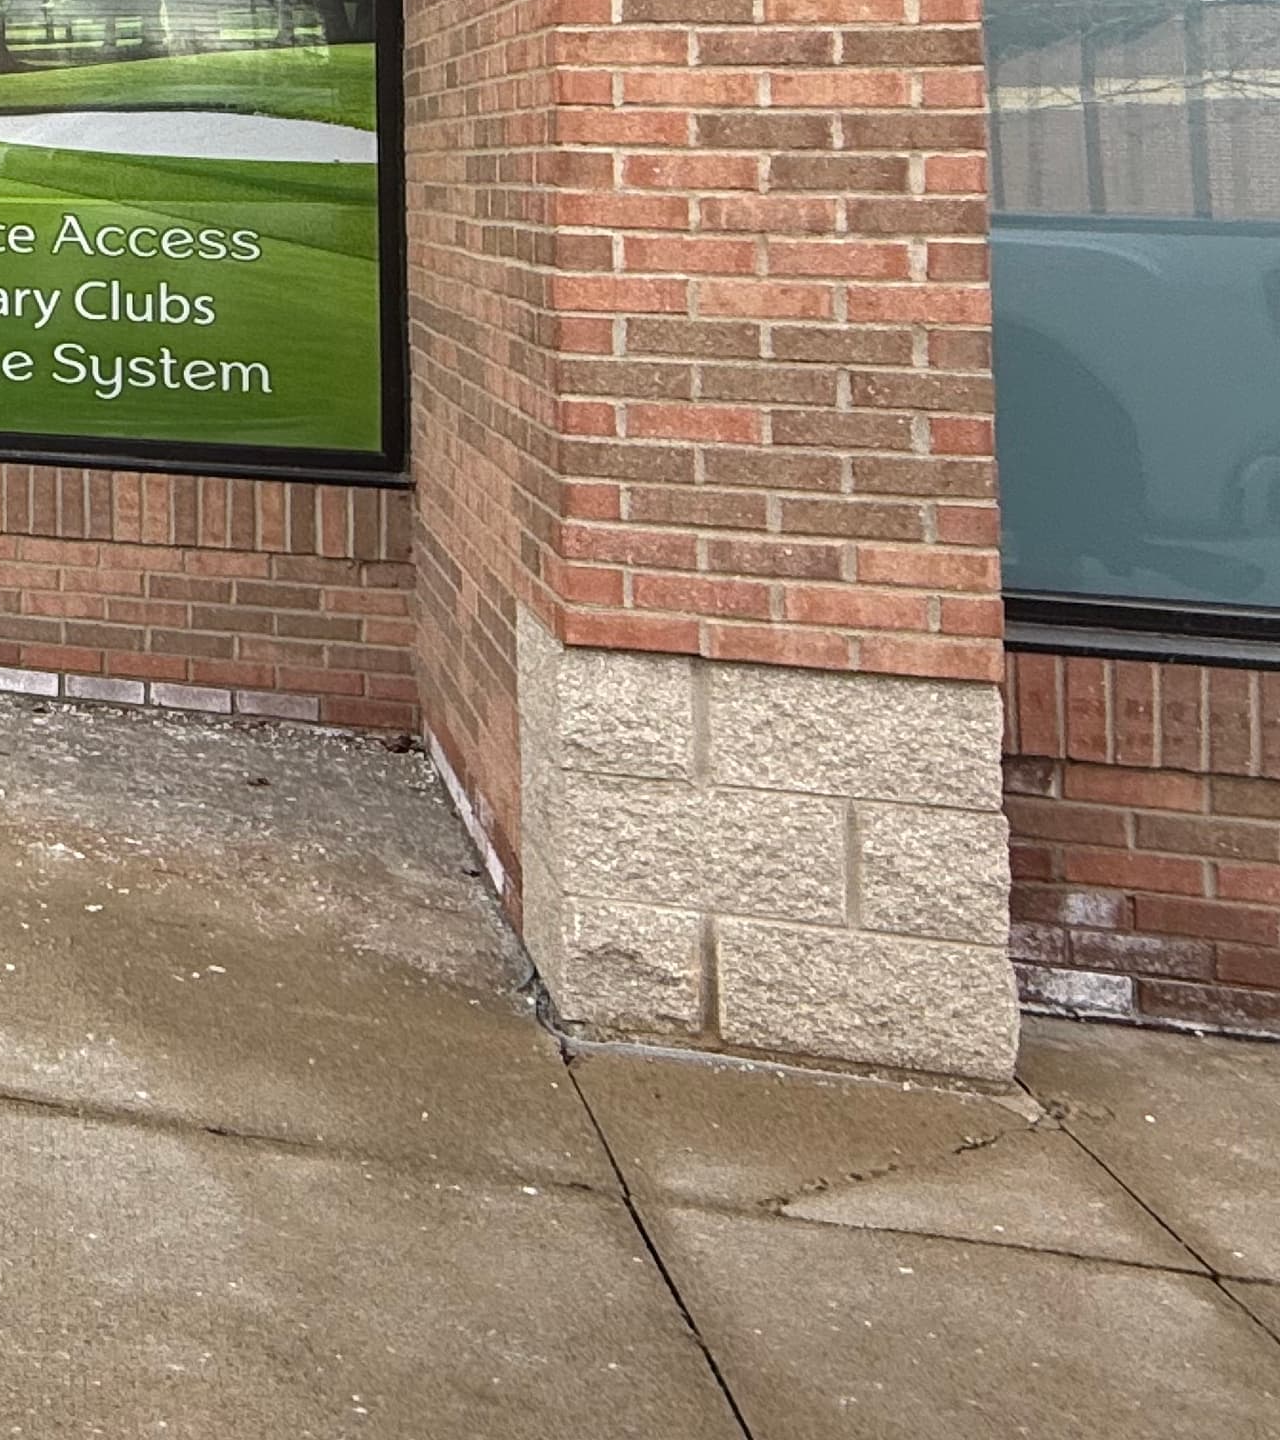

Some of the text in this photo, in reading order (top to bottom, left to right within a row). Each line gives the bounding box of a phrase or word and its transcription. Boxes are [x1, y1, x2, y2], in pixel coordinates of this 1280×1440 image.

[52, 215, 261, 260] Access
[74, 280, 216, 325] Clubs
[52, 343, 273, 399] System
